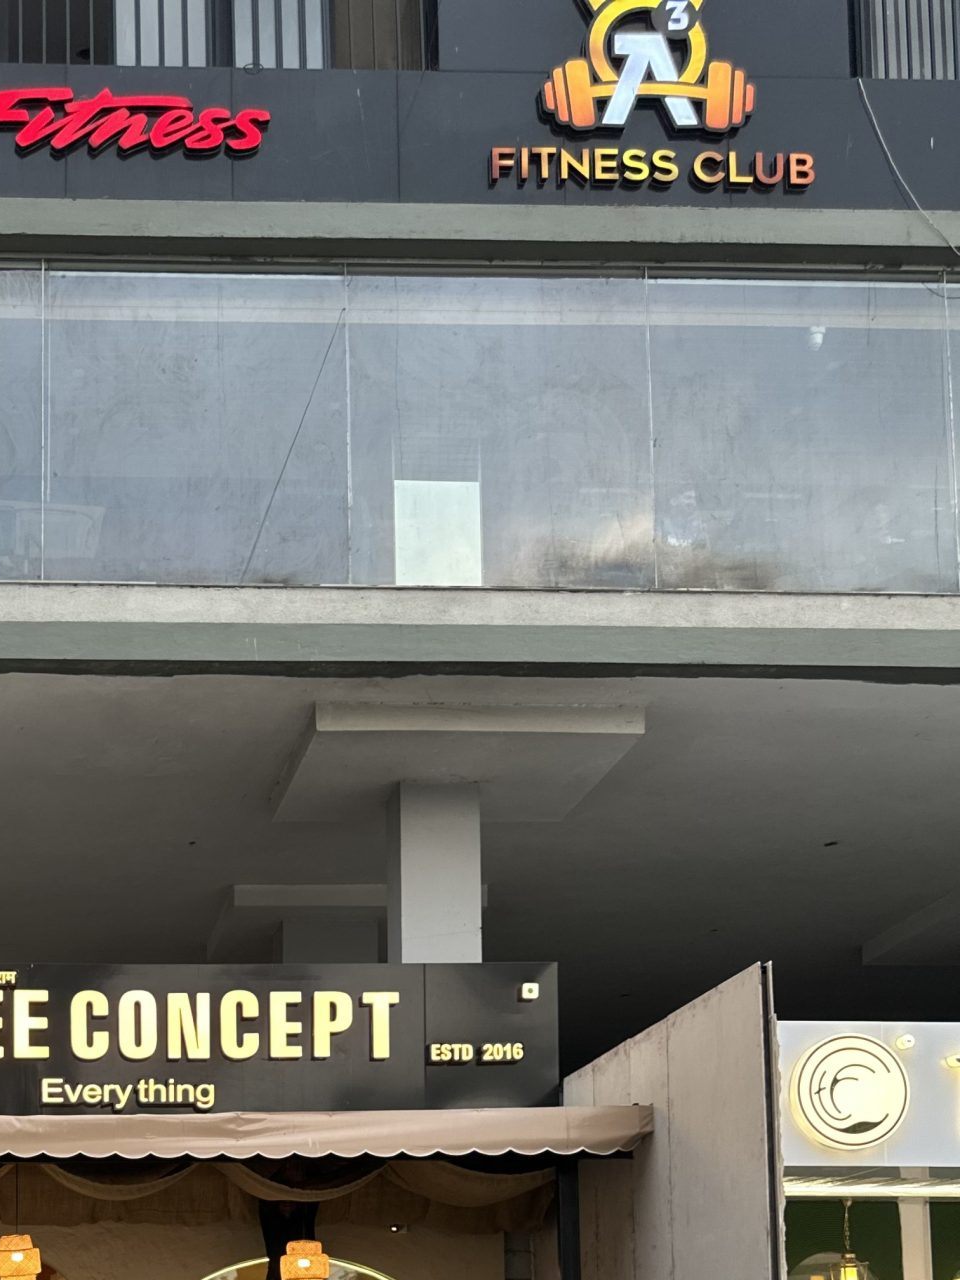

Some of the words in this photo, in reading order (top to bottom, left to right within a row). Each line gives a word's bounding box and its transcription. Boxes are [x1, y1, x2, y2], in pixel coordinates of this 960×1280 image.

[491, 146, 679, 182] FITNESS
[693, 150, 816, 185] CLUB
[70, 989, 400, 1060] CONCEPT
[430, 1043, 474, 1061] ESTD
[482, 1042, 524, 1061] 2016
